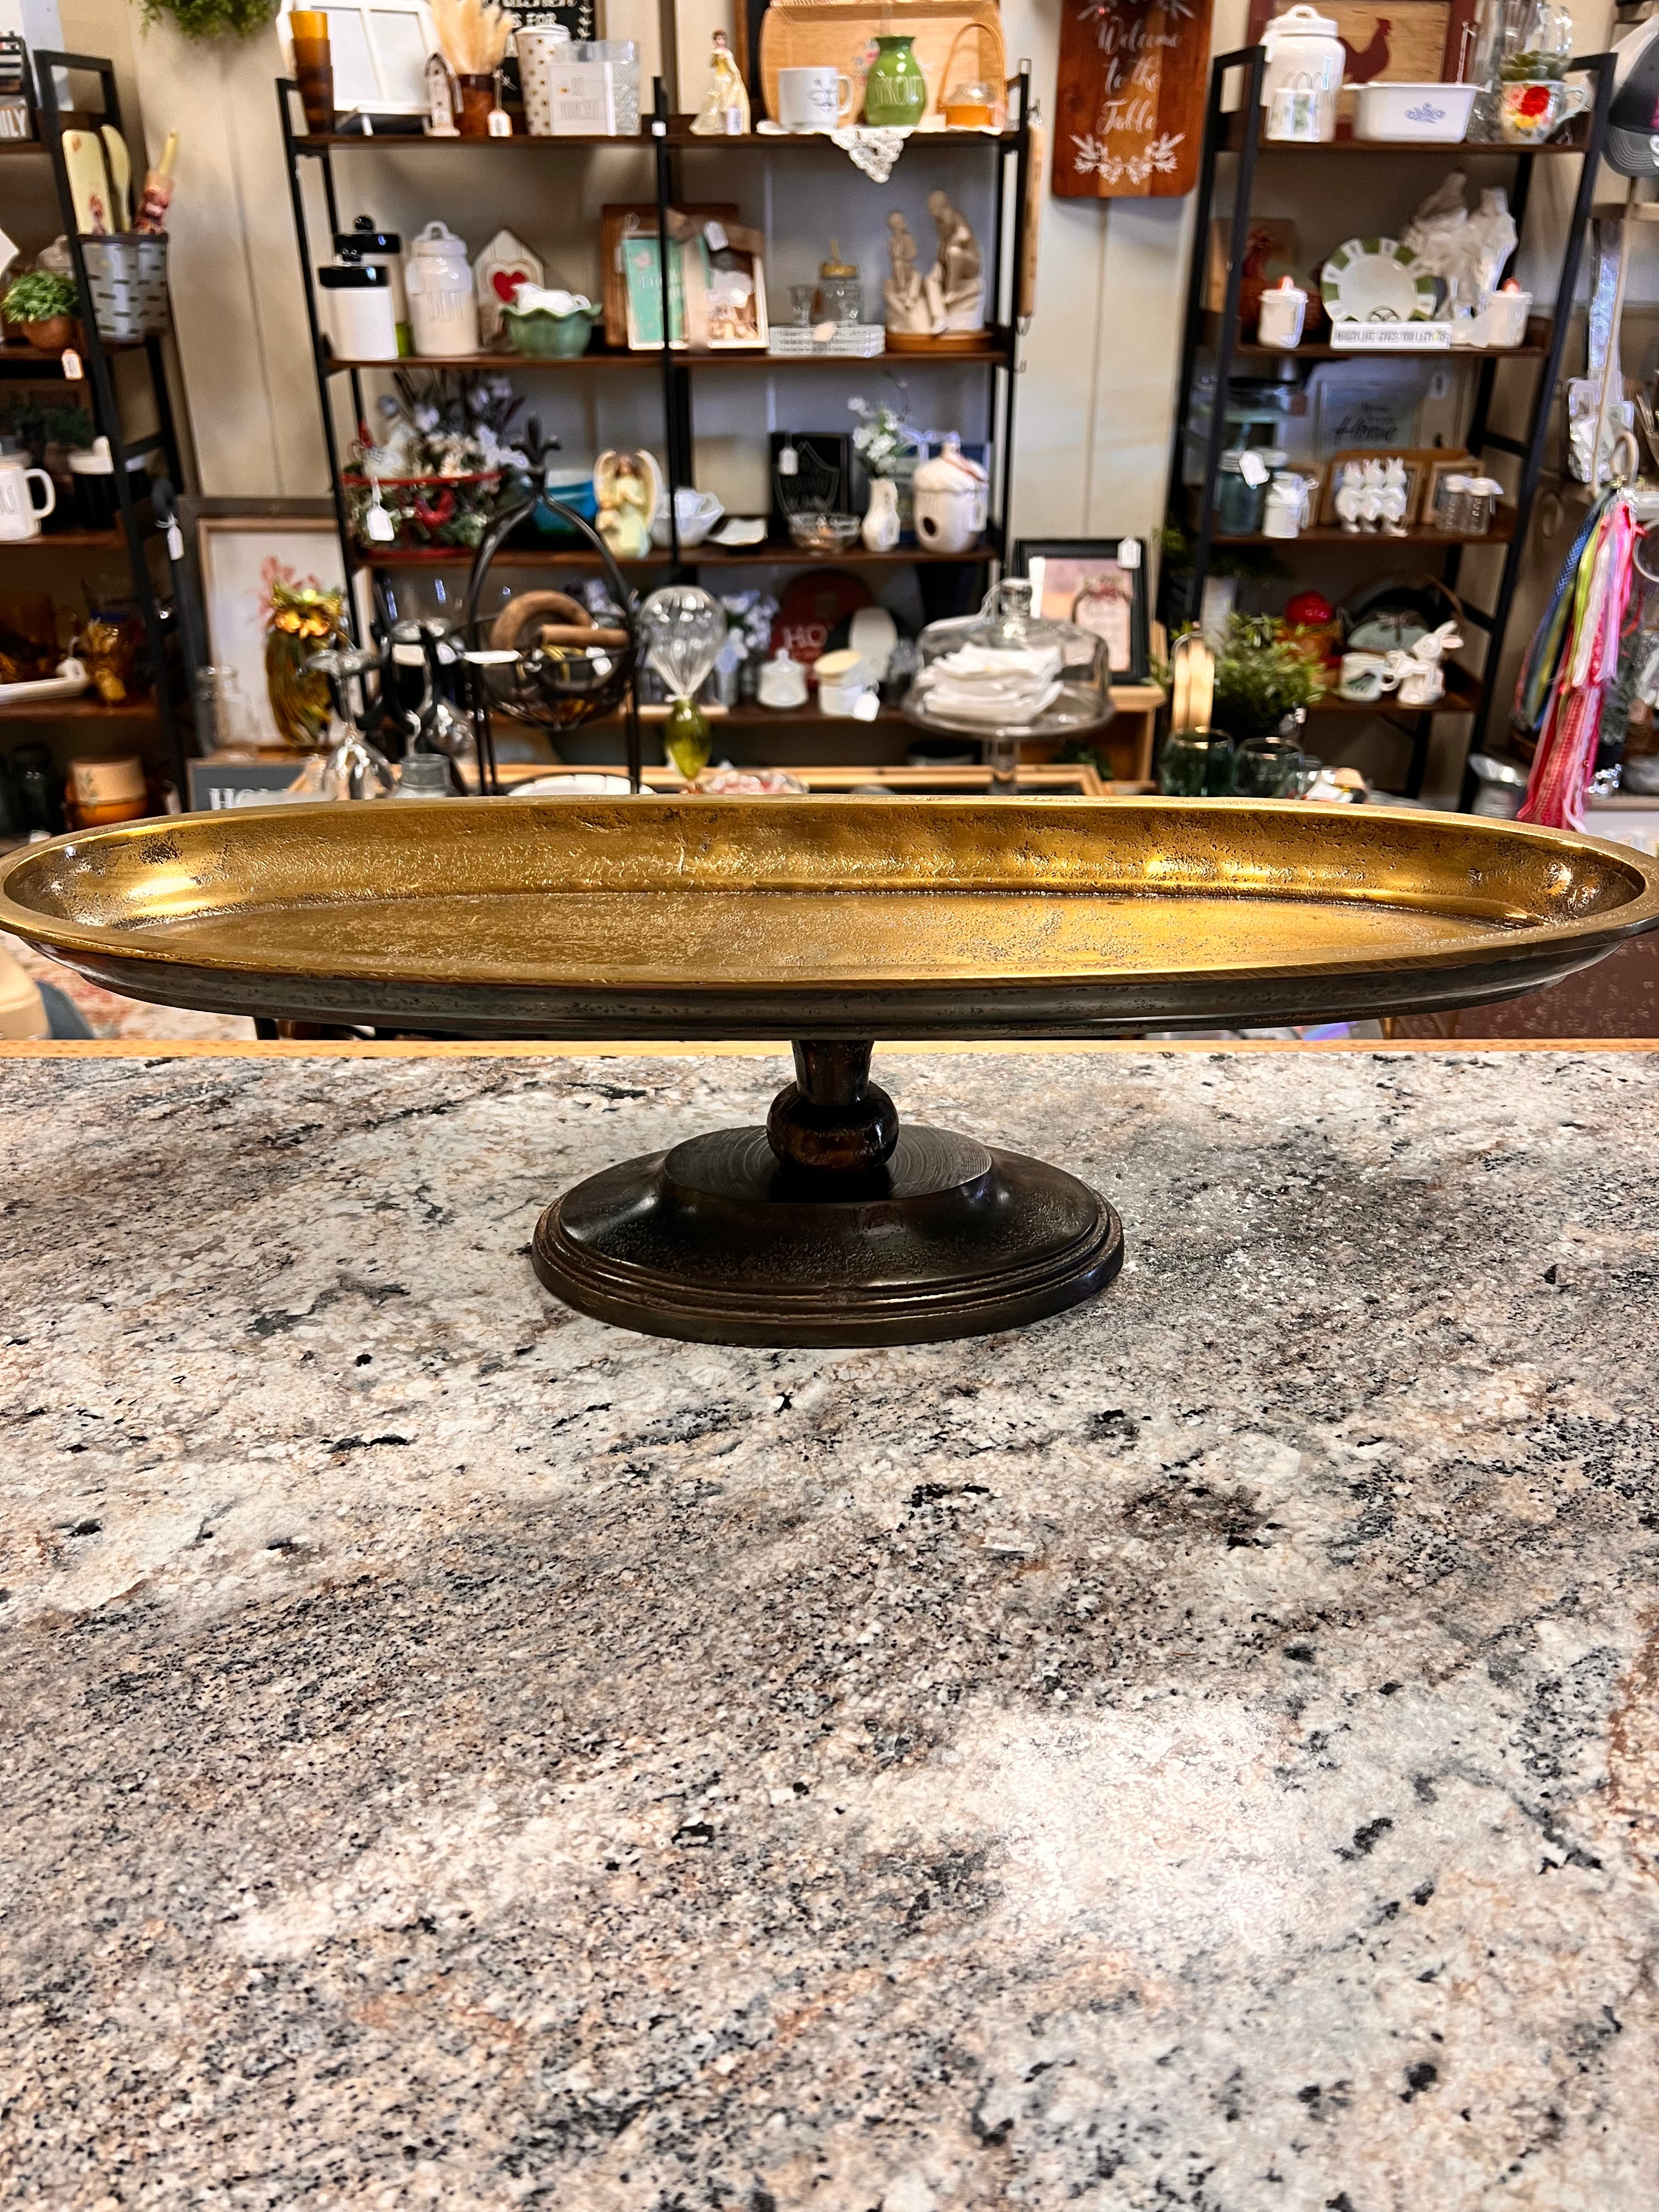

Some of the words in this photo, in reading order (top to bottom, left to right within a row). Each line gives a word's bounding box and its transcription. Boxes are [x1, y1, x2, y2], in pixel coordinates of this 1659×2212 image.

[526, 11, 557, 27] FOR
[1098, 15, 1181, 55] Welcome
[1103, 55, 1125, 94] to
[1128, 54, 1161, 92] the
[1096, 97, 1159, 135] Table
